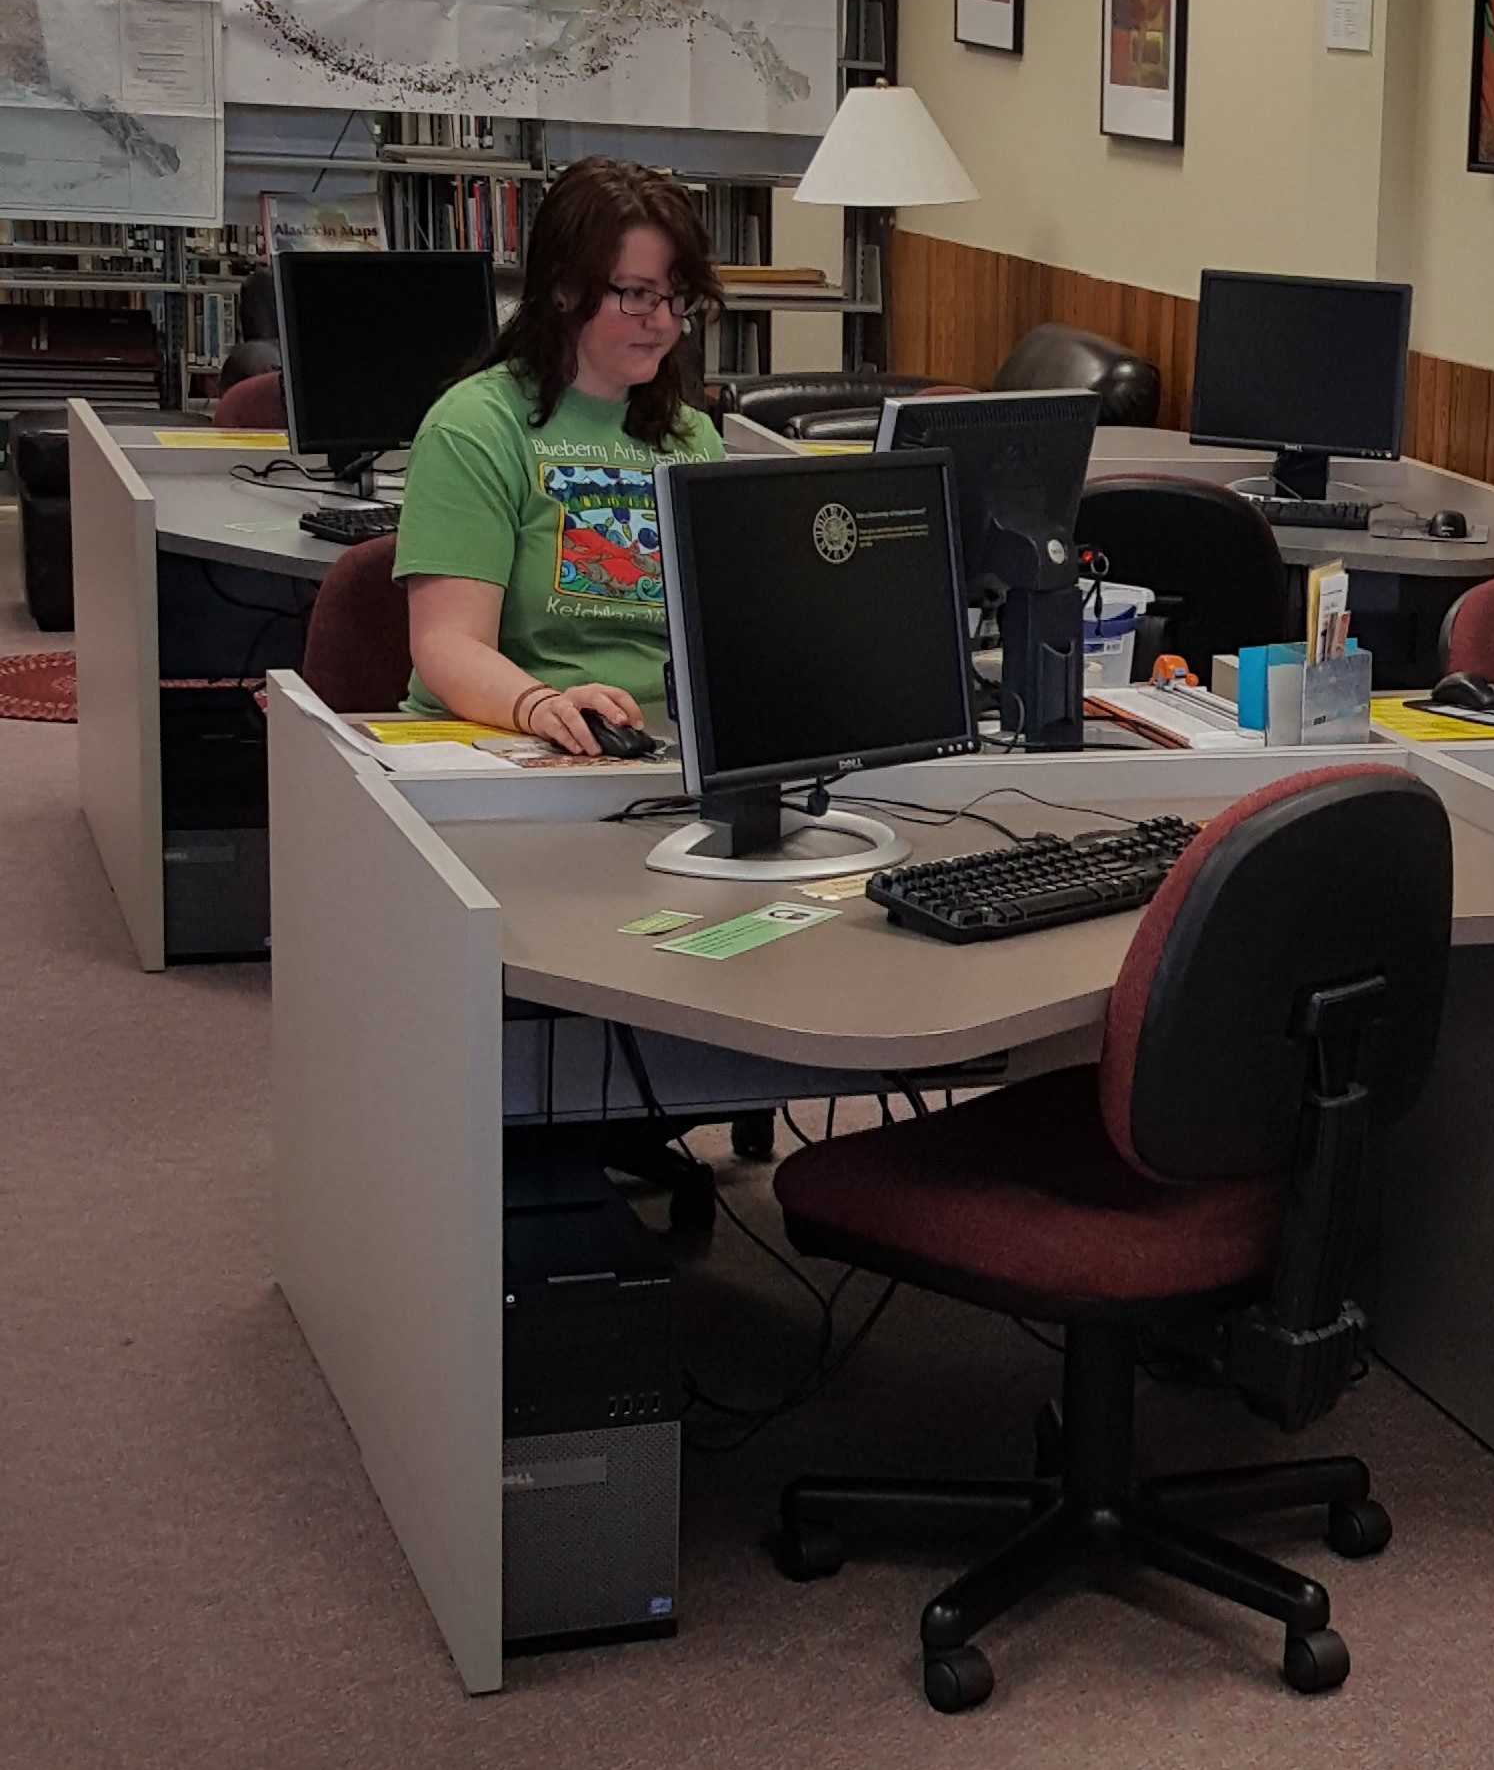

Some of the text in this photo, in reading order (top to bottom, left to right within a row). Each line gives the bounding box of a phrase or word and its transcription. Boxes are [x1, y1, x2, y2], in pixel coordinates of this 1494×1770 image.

[341, 226, 379, 241] Maps
[531, 438, 608, 462] Blueberry
[613, 441, 647, 462] Arts
